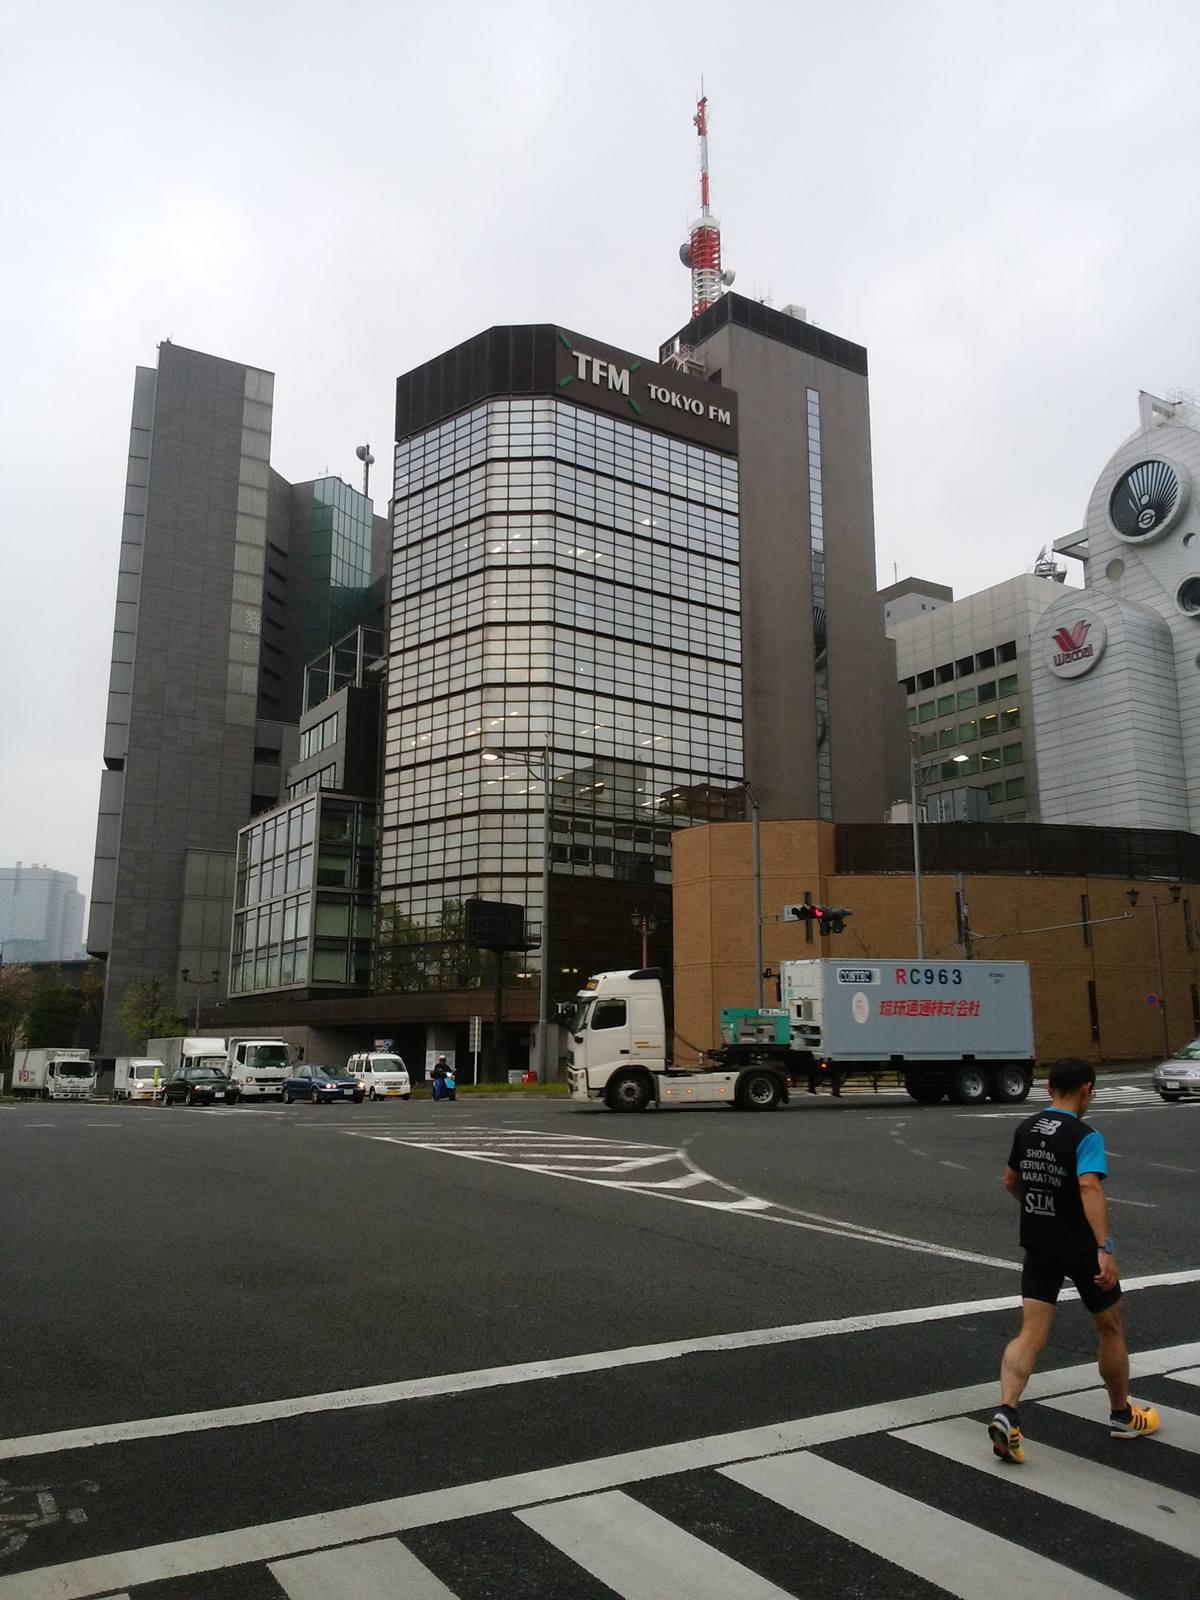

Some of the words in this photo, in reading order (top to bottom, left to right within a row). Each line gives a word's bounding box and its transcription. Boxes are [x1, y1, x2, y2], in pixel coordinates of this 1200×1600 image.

[572, 350, 630, 396] TFM
[648, 383, 705, 416] TOKYO
[709, 405, 731, 426] FM
[839, 969, 872, 982] CONTEC
[895, 968, 962, 985] RC963
[878, 999, 981, 1017] 琉球通運株式会社
